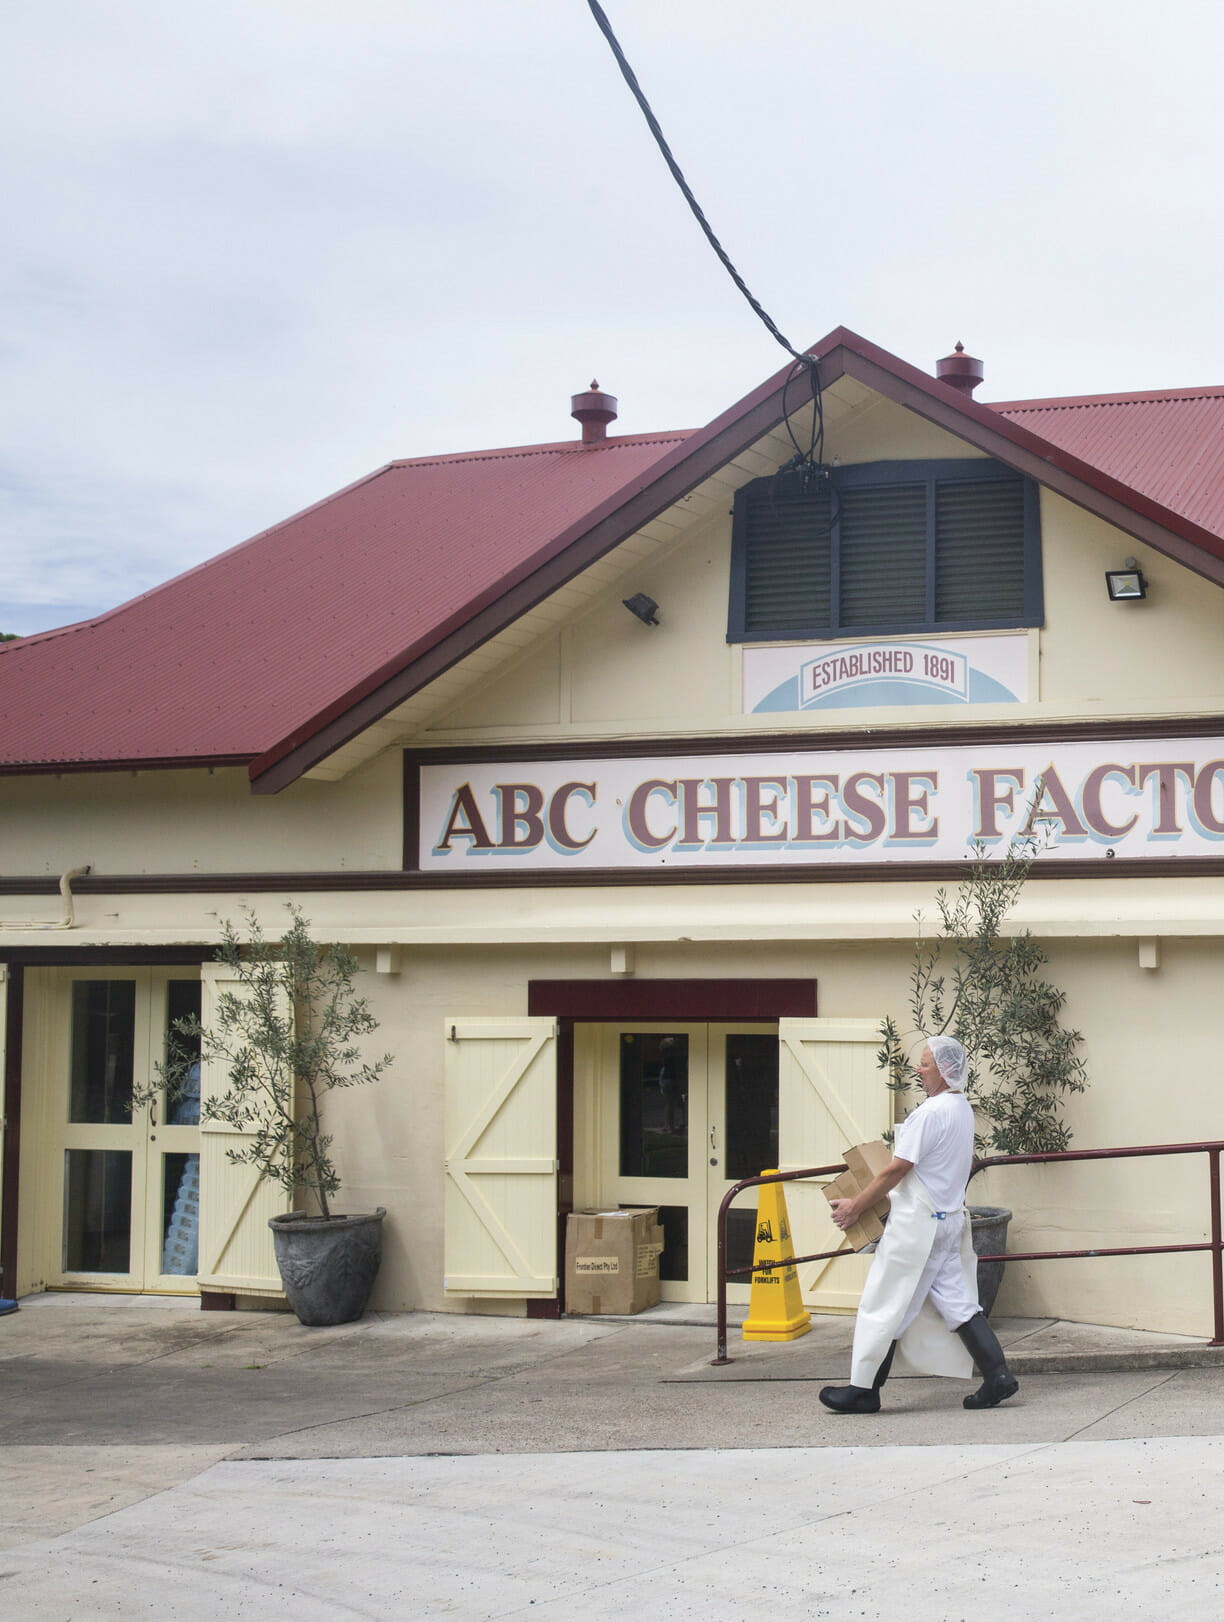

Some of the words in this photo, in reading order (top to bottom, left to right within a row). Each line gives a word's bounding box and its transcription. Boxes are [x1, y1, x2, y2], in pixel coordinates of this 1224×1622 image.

[812, 651, 914, 690] ESTABLISHED
[923, 653, 956, 683] 1891
[432, 781, 598, 856] ABC
[623, 770, 940, 853] CHEESE
